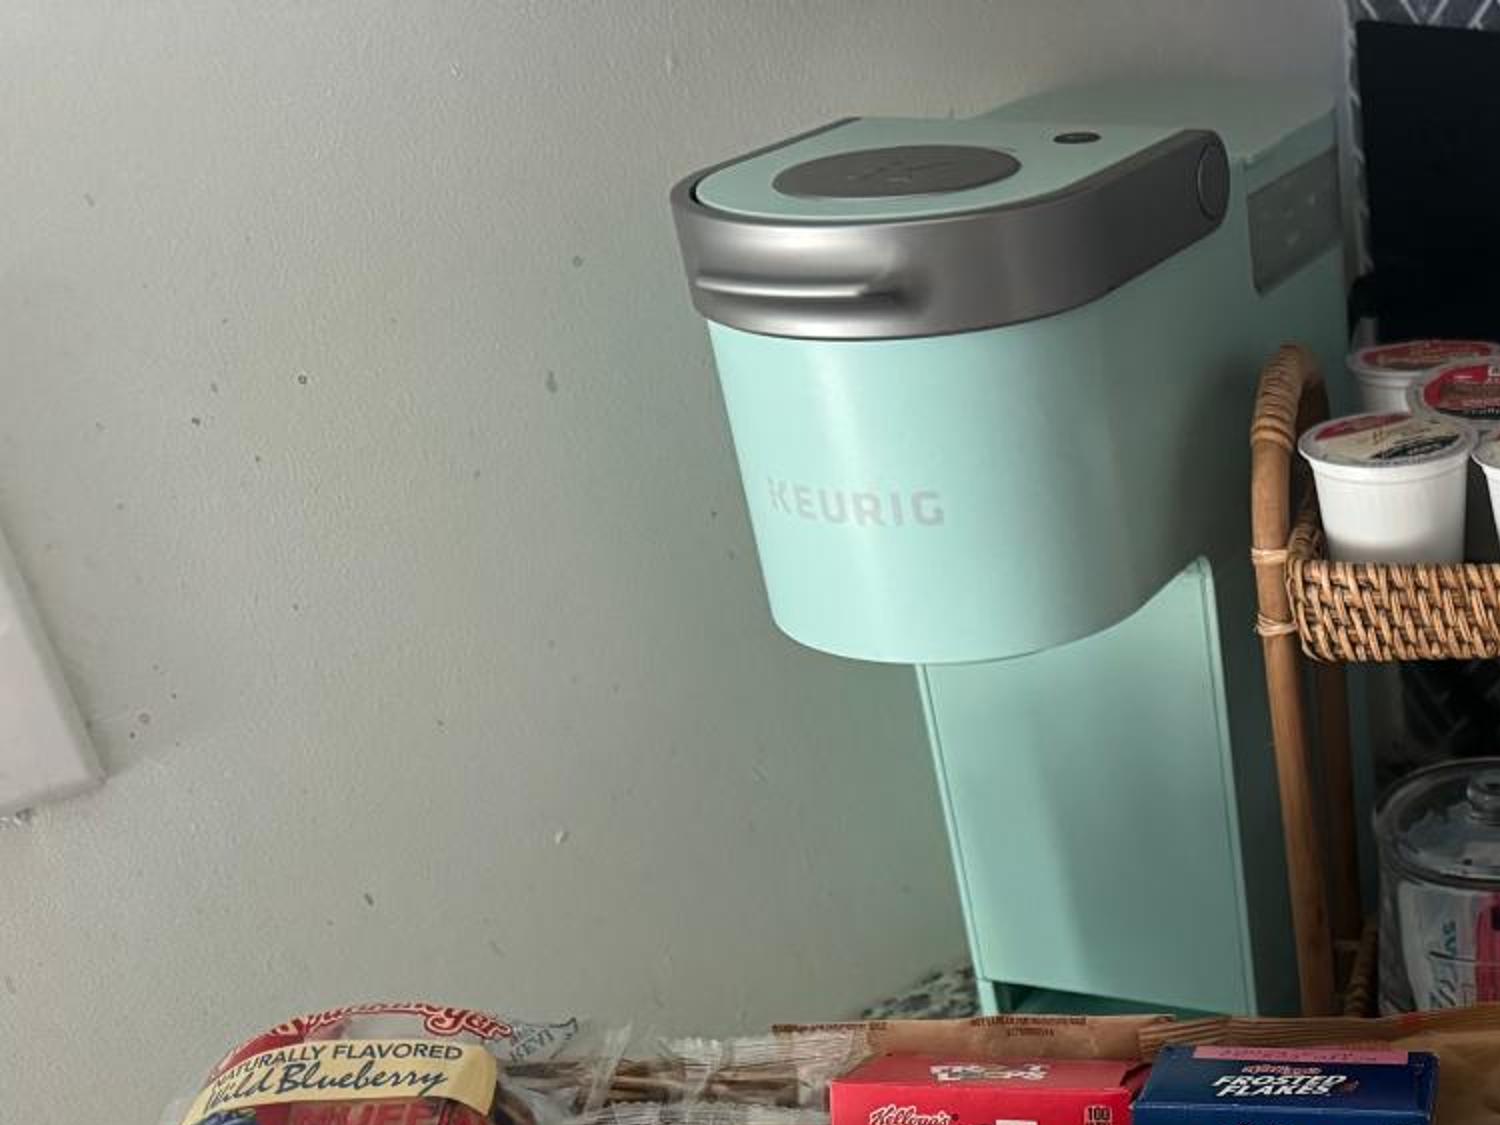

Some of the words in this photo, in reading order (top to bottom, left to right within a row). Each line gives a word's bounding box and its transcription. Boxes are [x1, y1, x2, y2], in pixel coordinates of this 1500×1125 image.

[768, 476, 945, 527] KEURIG
[332, 1043, 463, 1061] FLAVORED
[279, 1061, 448, 1097] Blueberry
[1211, 1075, 1347, 1087] FROSTED
[1215, 1085, 1331, 1097] FLAKES
